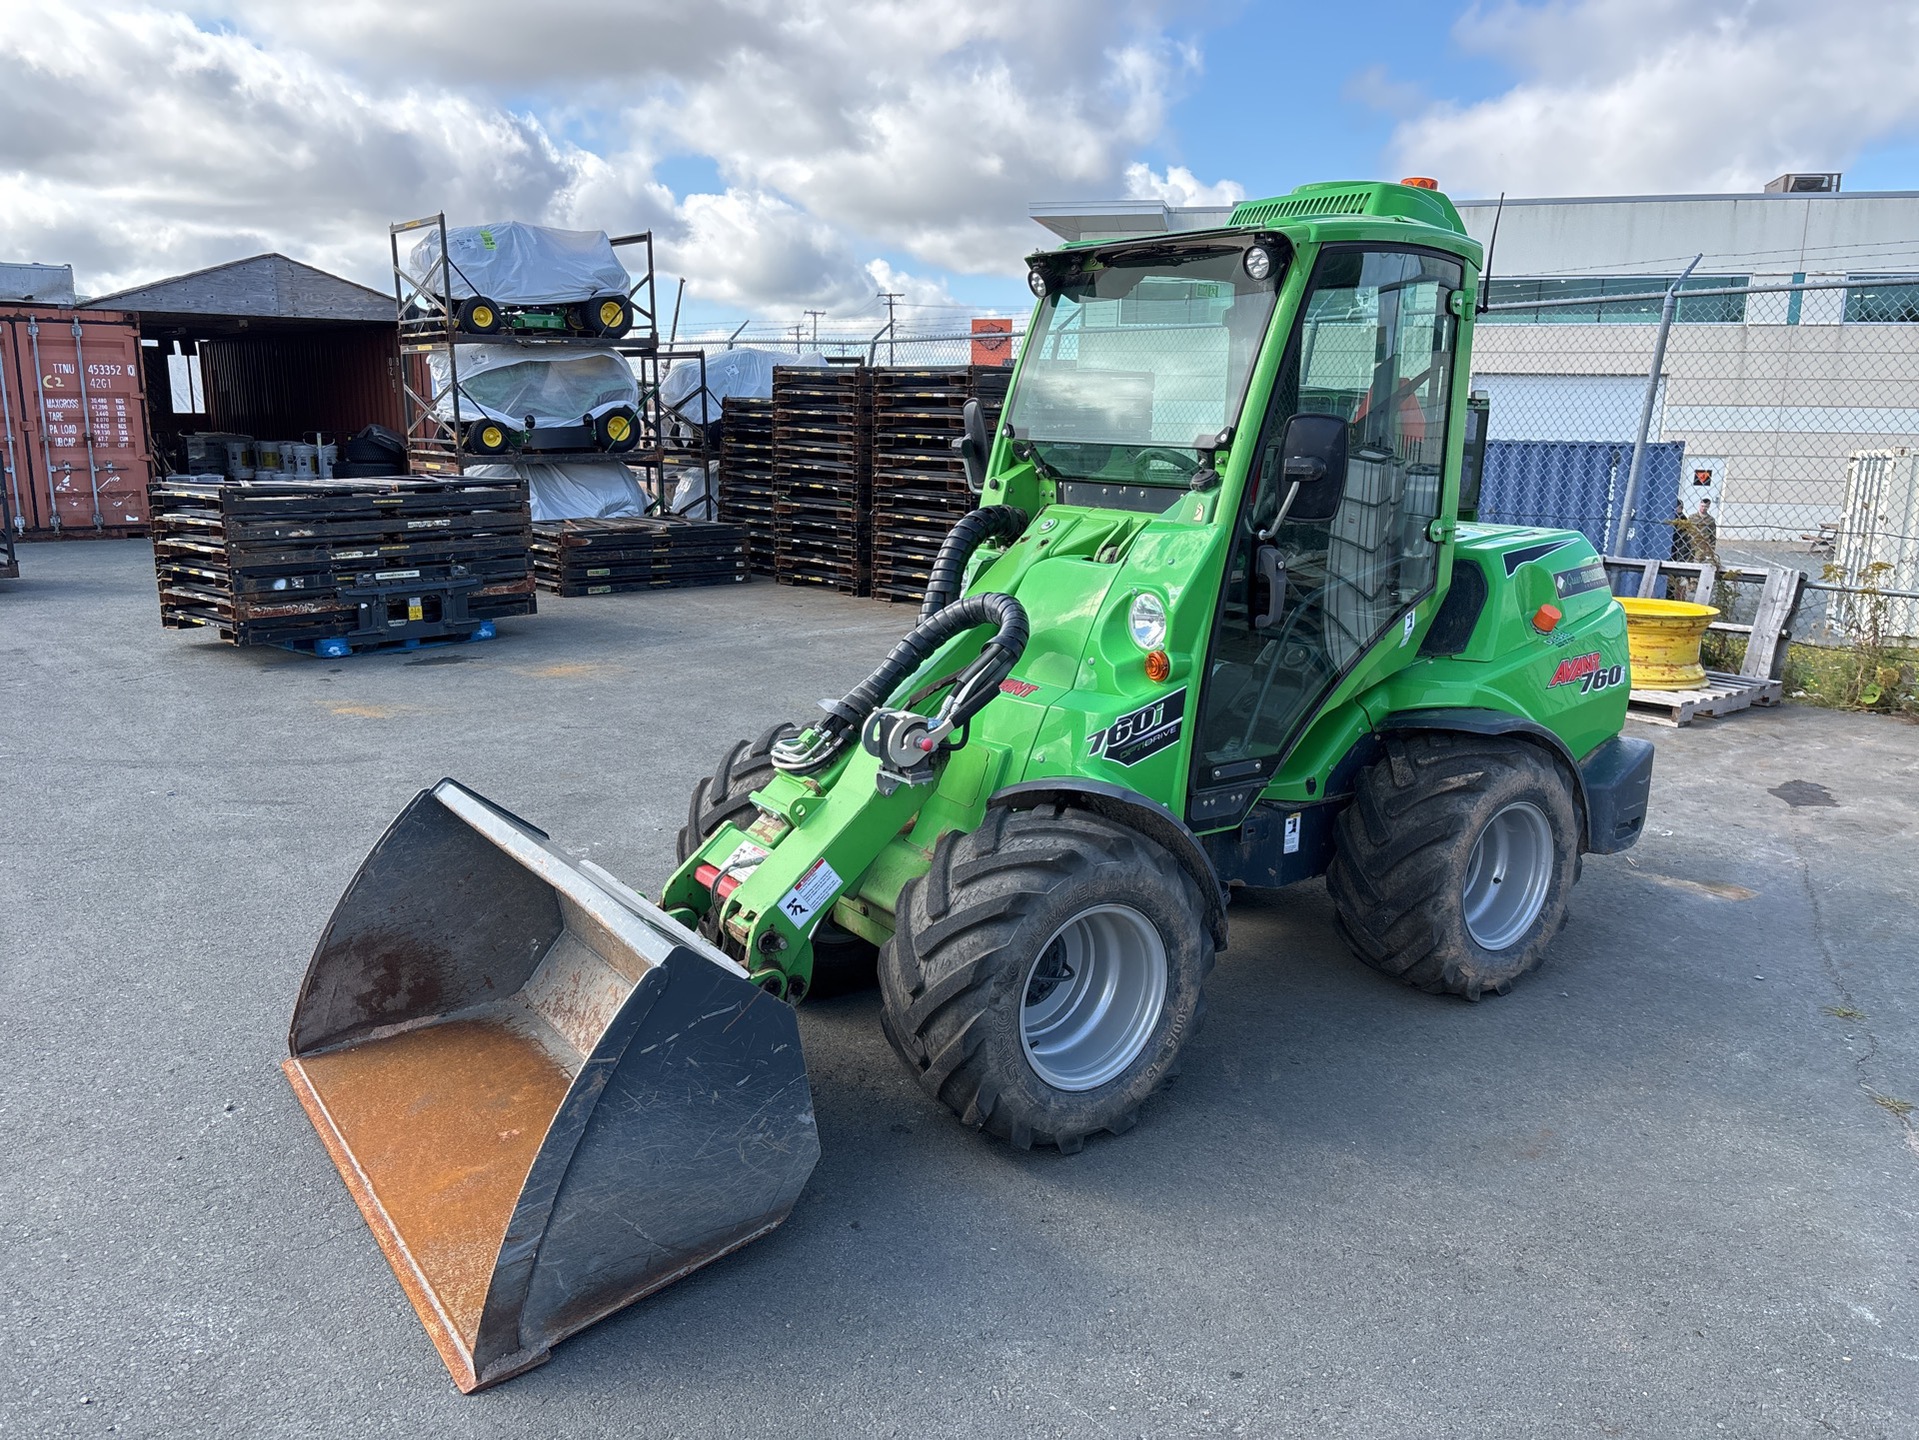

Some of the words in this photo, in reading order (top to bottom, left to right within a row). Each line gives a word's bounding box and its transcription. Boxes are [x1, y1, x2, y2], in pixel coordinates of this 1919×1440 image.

[53, 364, 75, 374] TTNU
[88, 364, 121, 376] 453352
[90, 378, 111, 389] 42G1
[48, 411, 64, 422] TARE
[1546, 650, 1601, 689] AVANT
